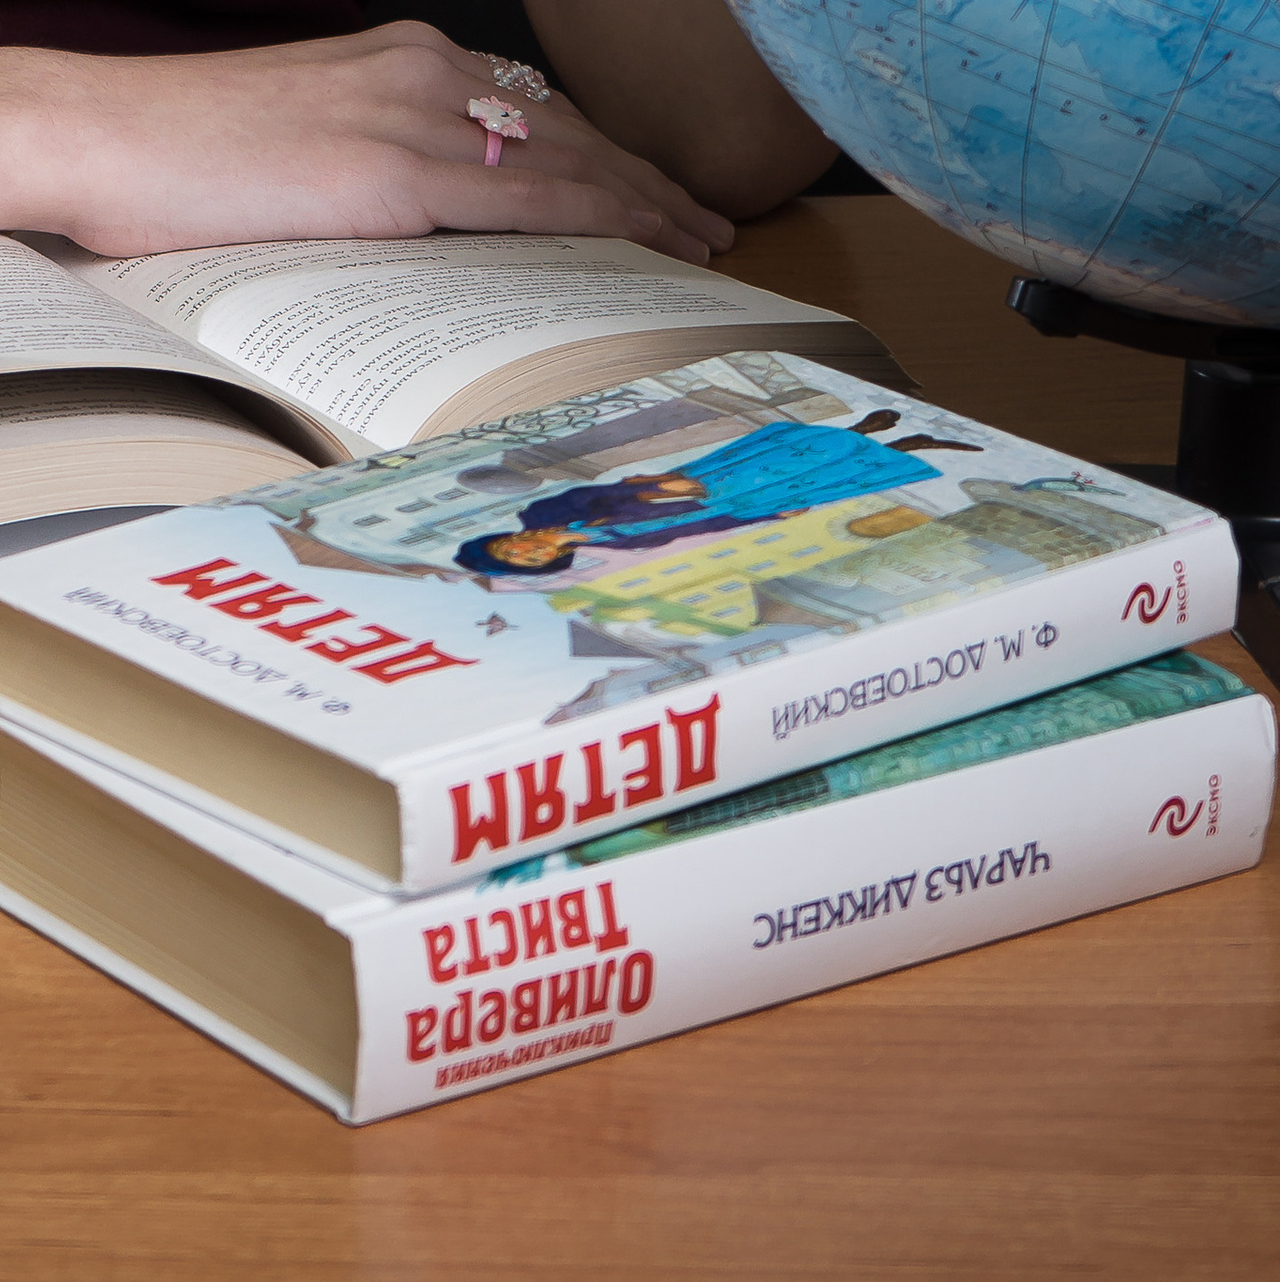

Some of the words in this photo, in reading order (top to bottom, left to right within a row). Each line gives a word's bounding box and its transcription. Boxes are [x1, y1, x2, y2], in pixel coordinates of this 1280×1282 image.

[323, 347, 356, 376] Если
[149, 556, 482, 686] ДЕТЯМ
[1175, 559, 1189, 626] ЭКСМО
[771, 641, 986, 741] ДОСТОЕВСКИЙ
[449, 692, 723, 864] ДЕТЯМ
[1205, 773, 1223, 838] ЭКСМО
[925, 840, 1052, 899] ЧАРЛЬЗ
[752, 868, 916, 951] ДИККЕНС
[434, 1020, 615, 1090] Приключения
